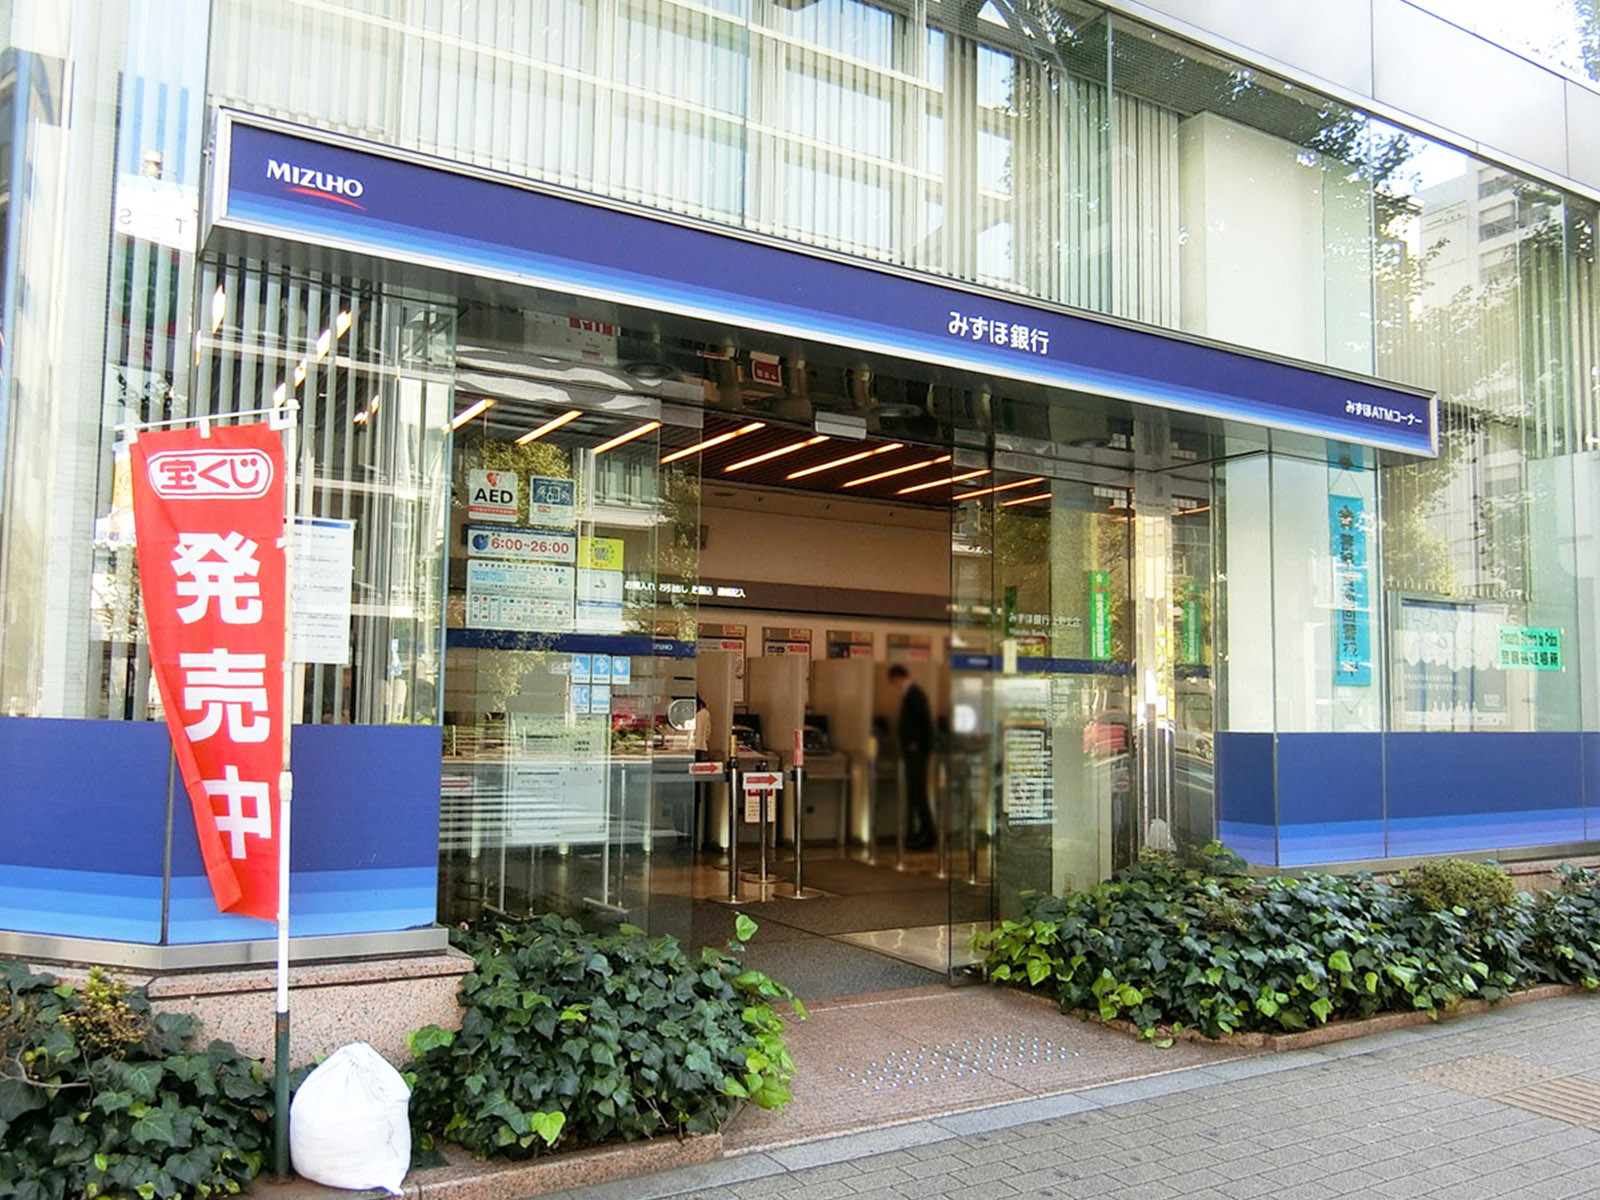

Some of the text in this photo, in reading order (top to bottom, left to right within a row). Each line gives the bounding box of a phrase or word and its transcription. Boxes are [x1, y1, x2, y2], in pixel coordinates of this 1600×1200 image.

[266, 158, 364, 197] MIZUHO
[948, 311, 1050, 355] みずほ銀行
[1345, 400, 1423, 426] みずほATMコーナー
[159, 458, 260, 490] 宝くじ
[474, 487, 513, 505] AED
[170, 530, 273, 860] 発売中
